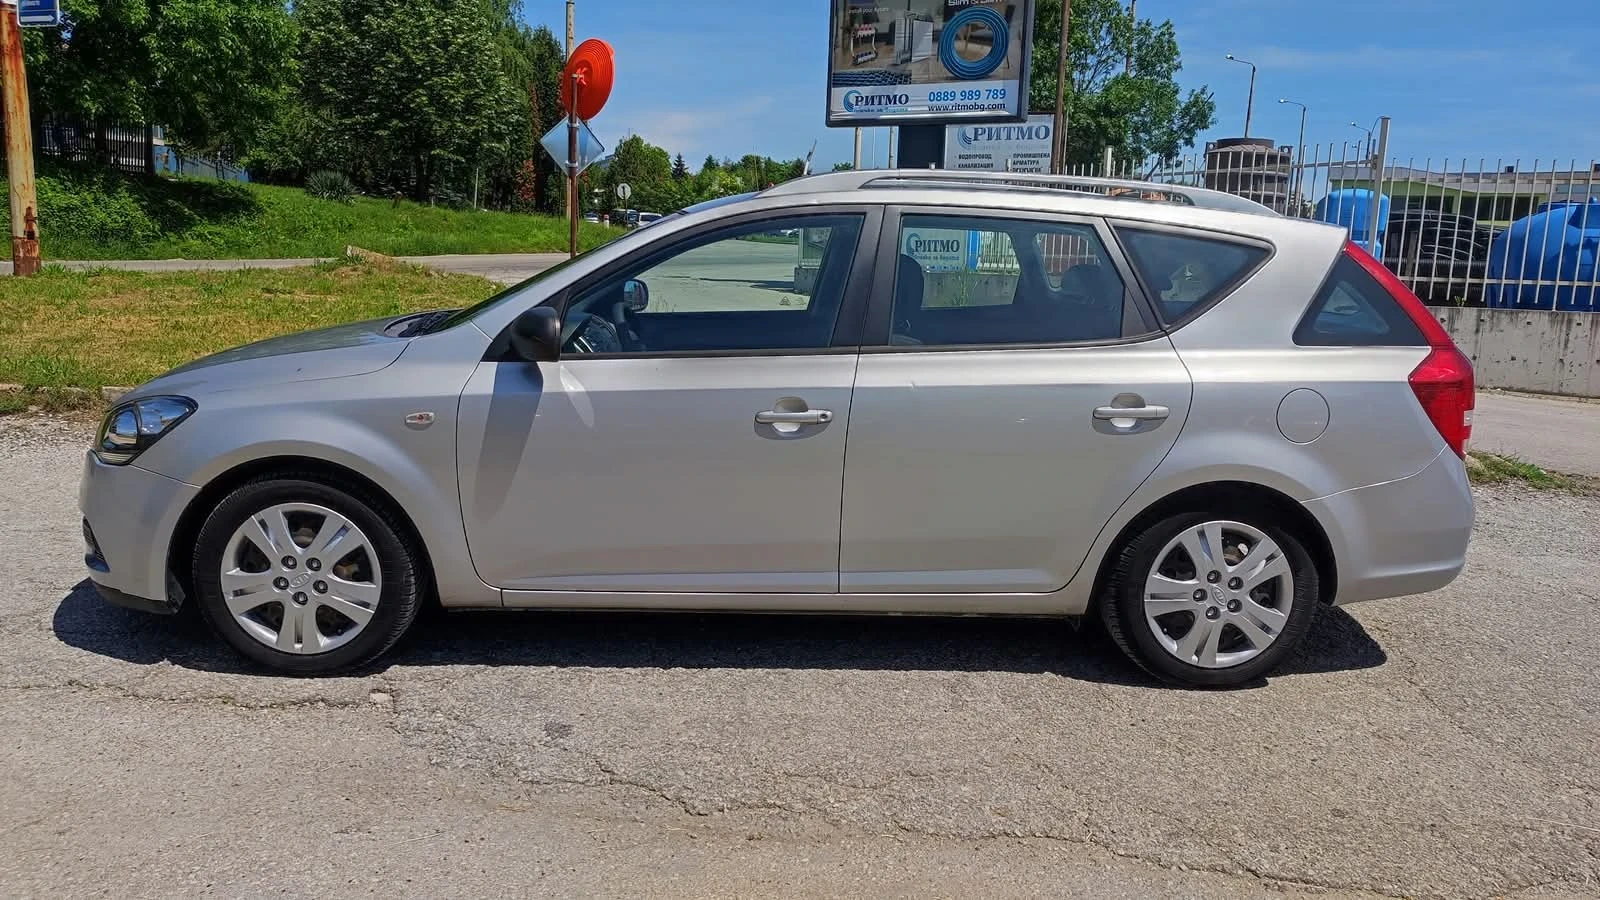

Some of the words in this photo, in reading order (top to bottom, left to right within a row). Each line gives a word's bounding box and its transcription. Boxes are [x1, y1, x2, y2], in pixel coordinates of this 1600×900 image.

[855, 94, 909, 106] РИТМО
[928, 90, 956, 102] 0889
[960, 90, 981, 101] 989
[985, 88, 1006, 100] 789
[928, 102, 1006, 112] www.ritmobg.com
[973, 125, 1050, 141] РИТМО
[914, 239, 960, 253] РИТМО
